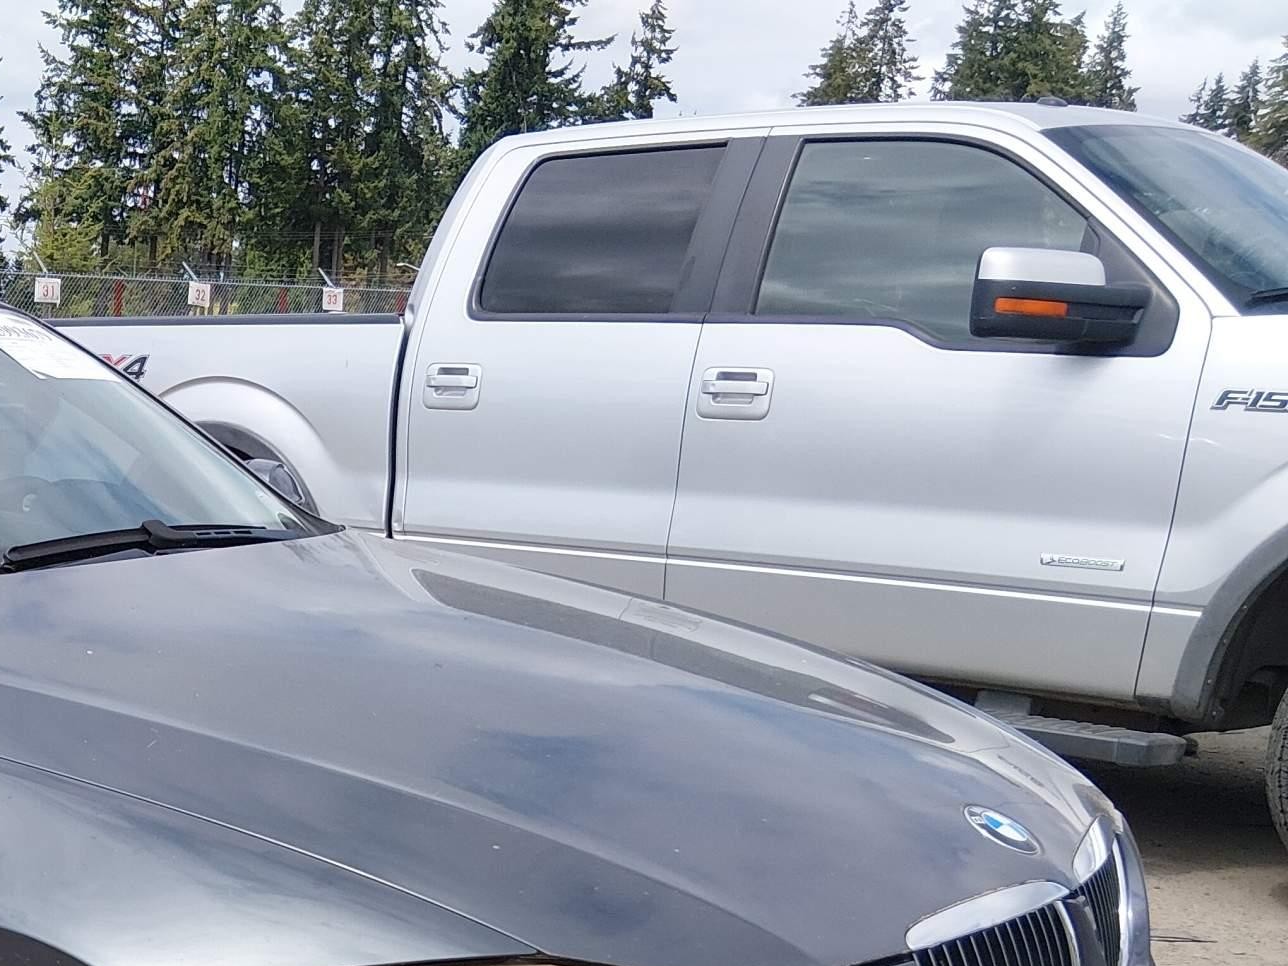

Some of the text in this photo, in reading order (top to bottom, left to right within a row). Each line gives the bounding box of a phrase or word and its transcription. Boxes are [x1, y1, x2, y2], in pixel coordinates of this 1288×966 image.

[42, 285, 55, 297] 31
[195, 288, 206, 301] 32
[327, 294, 338, 305] 33
[1210, 389, 1288, 413] F-15
